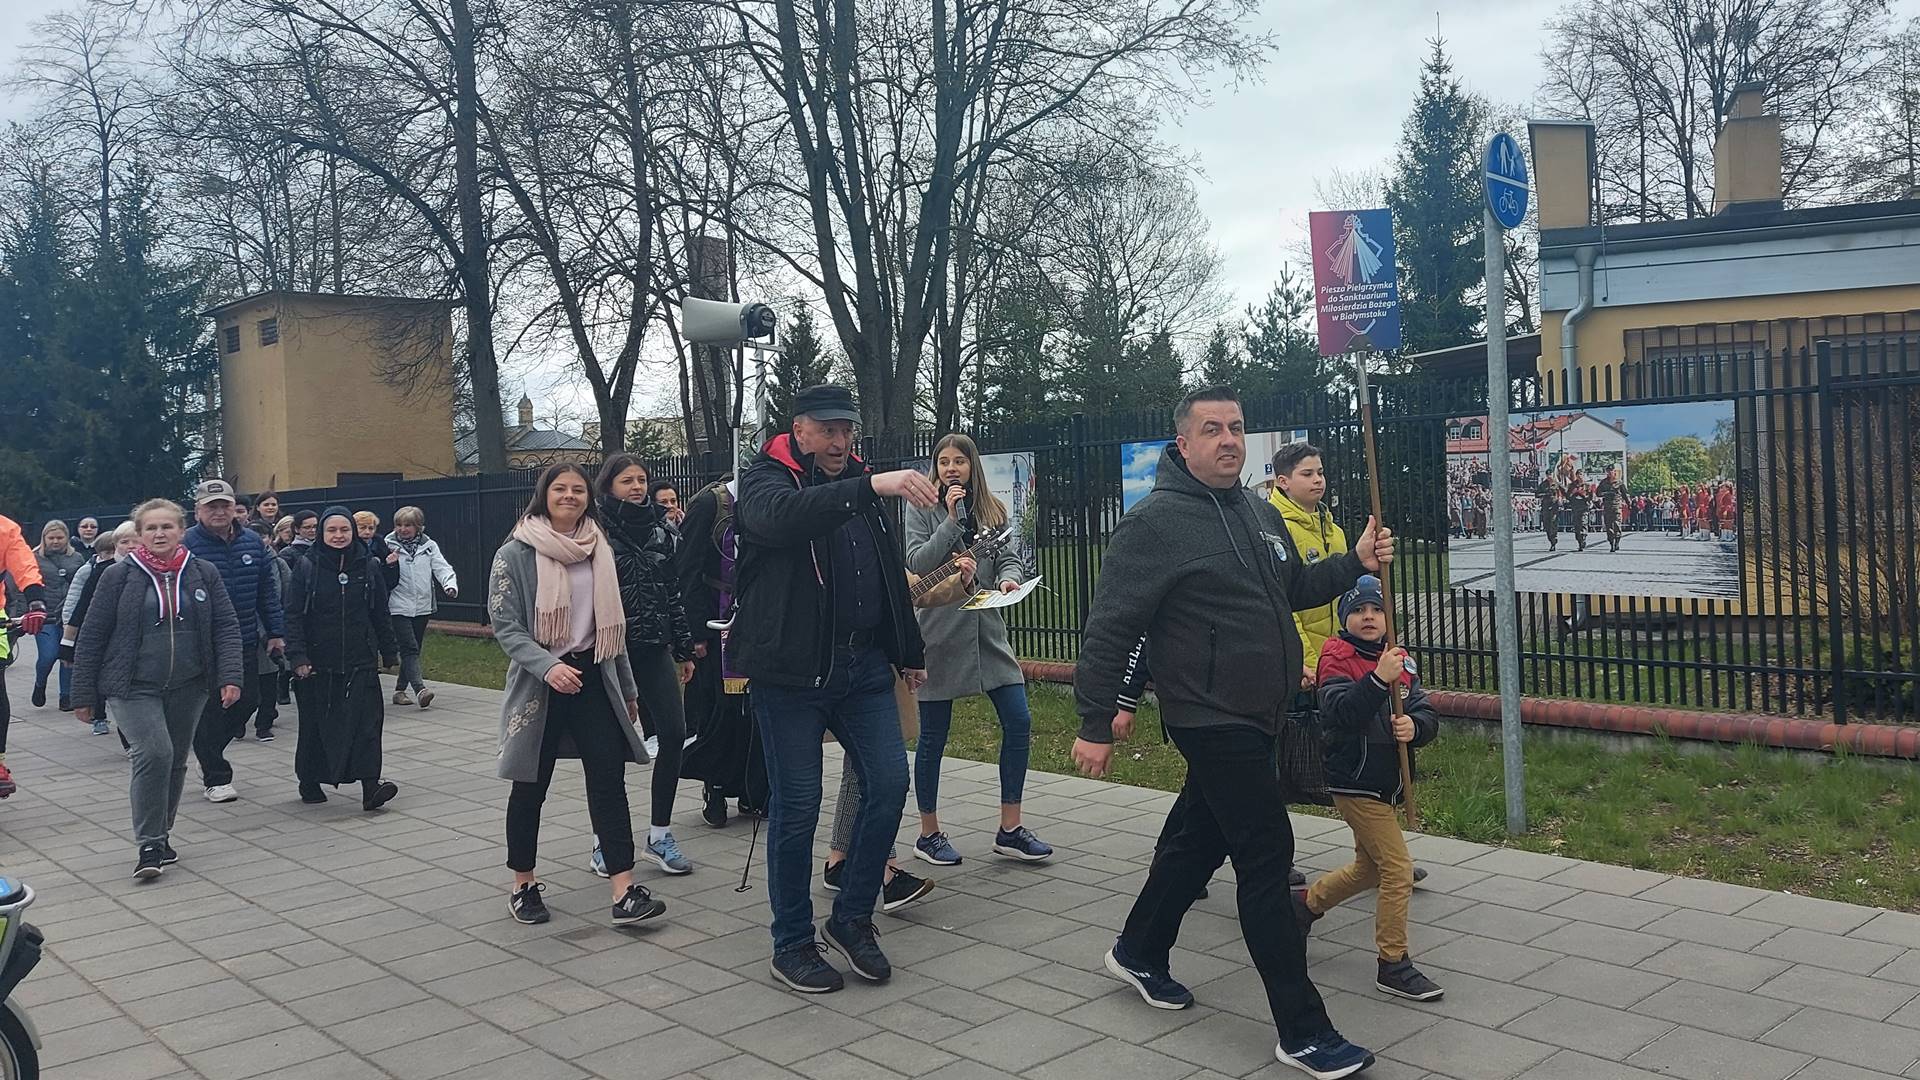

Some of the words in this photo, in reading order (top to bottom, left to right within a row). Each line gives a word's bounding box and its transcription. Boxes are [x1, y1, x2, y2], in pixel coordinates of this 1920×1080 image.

[1321, 285, 1346, 294] Piesza
[1346, 281, 1393, 293] Pielgrzymka
[1328, 295, 1338, 303] do
[1339, 291, 1388, 302] Sanktuarium
[1320, 303, 1367, 313] Miłosierdzia
[1368, 300, 1396, 309] Bożego
[1340, 310, 1387, 321] Białymstoku
[623, 898, 636, 912] N
